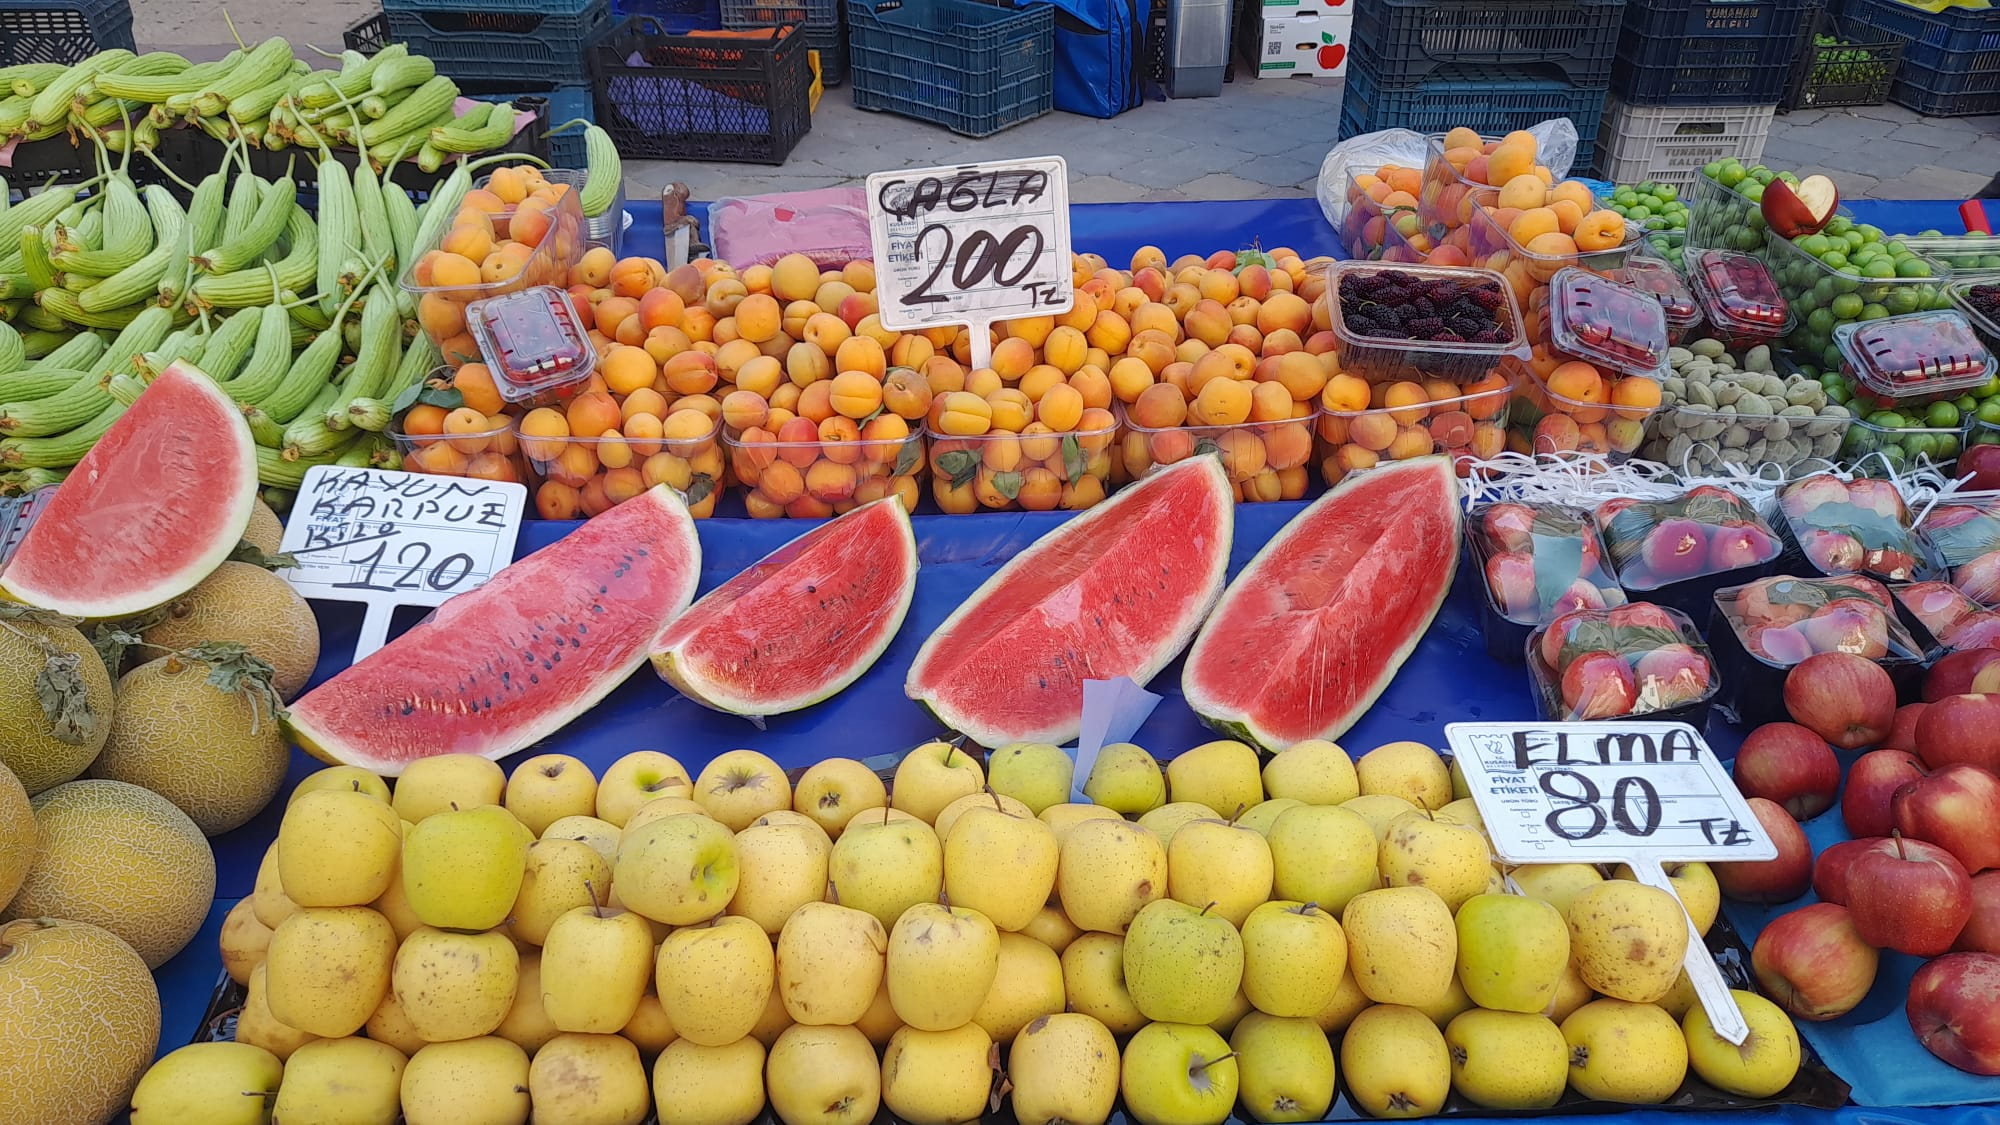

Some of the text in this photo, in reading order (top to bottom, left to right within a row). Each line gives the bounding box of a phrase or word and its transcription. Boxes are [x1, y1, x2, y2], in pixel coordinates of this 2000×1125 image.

[1705, 7, 1759, 19] TUNAHAN
[1664, 148, 1723, 157] TUNAHAN
[888, 250, 923, 262] ETİKEİ
[899, 223, 1044, 306] 200
[332, 540, 475, 592] 120
[1512, 729, 1701, 769] ELMA
[1491, 775, 1527, 784] FİYAT
[1490, 785, 1539, 795] ETİKETİ
[1540, 770, 1662, 840] 80
